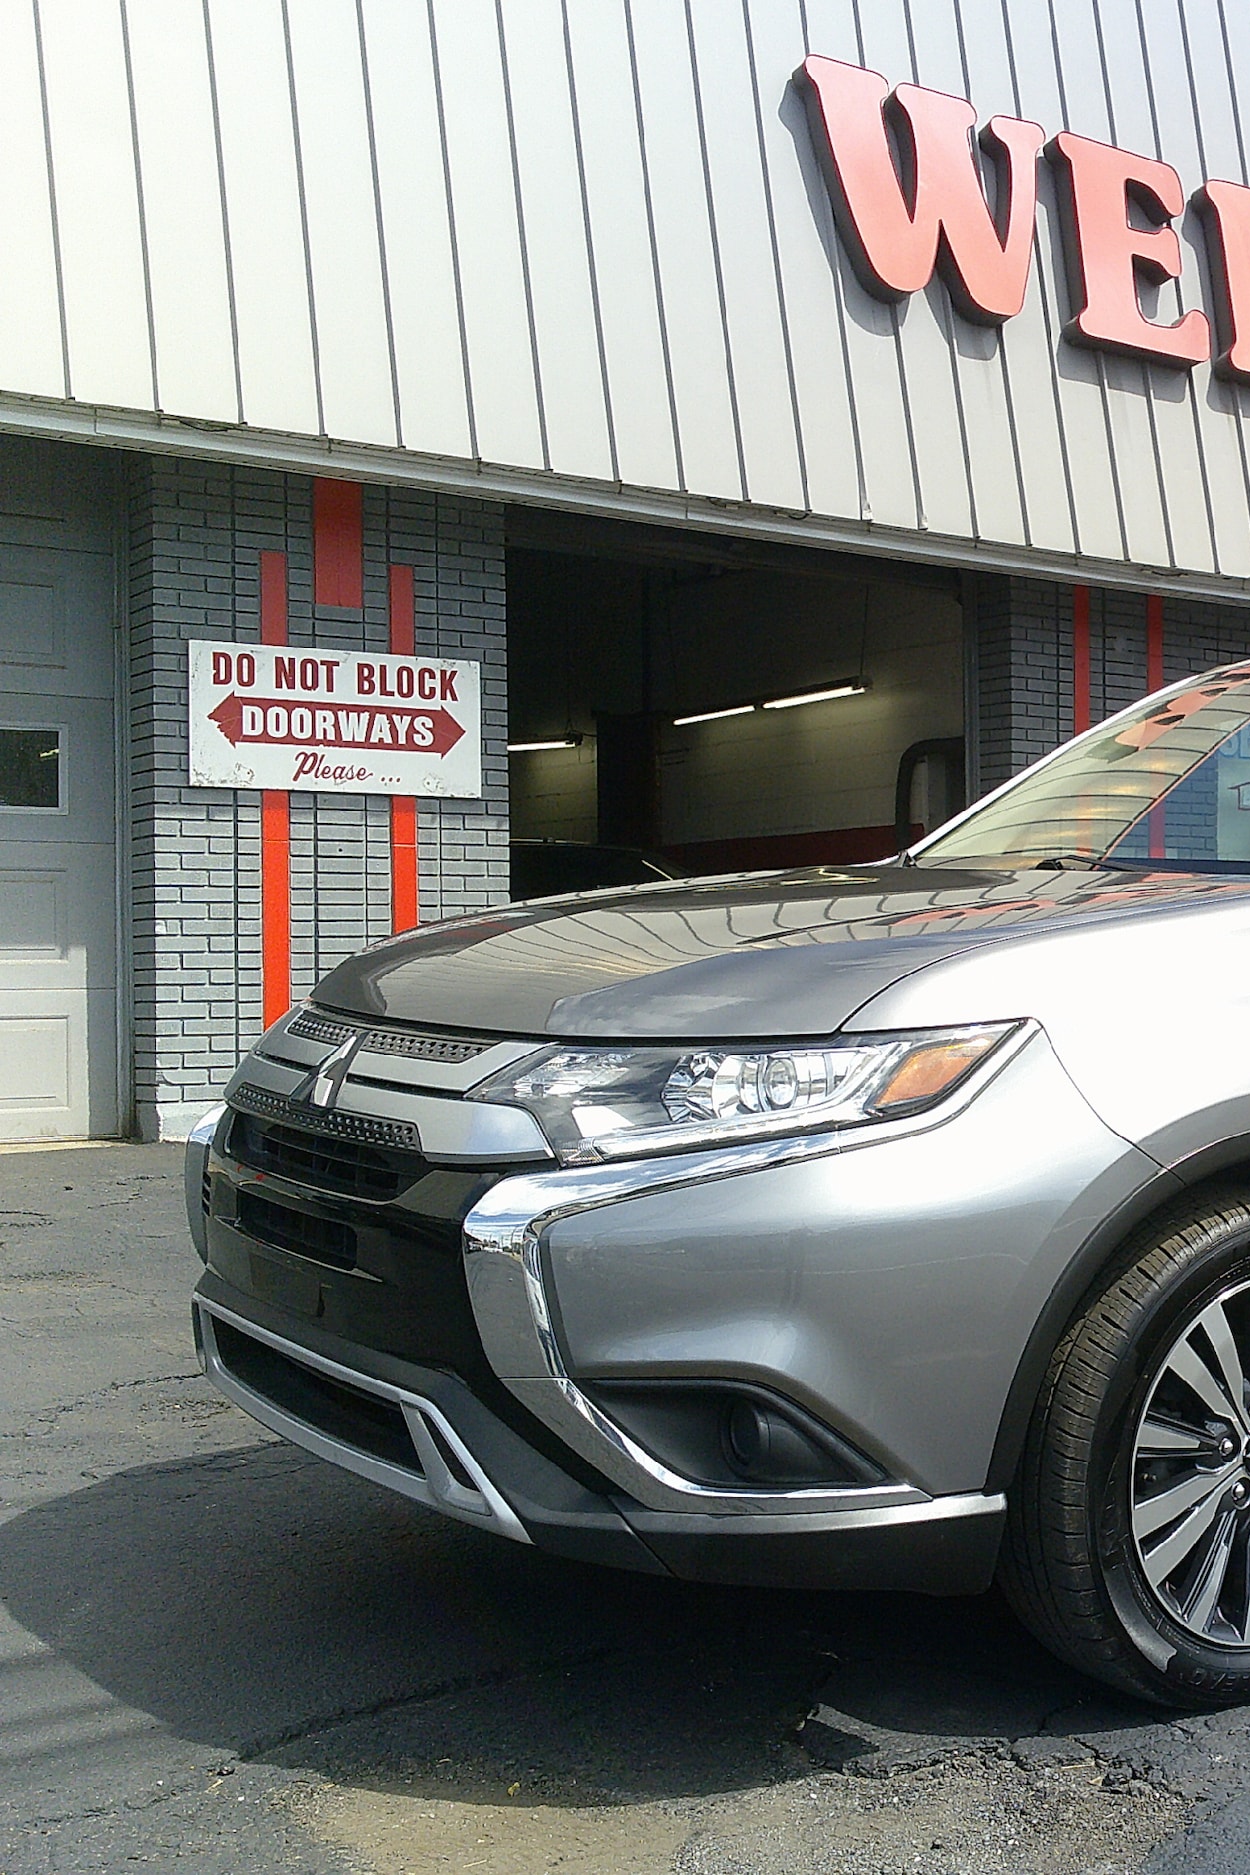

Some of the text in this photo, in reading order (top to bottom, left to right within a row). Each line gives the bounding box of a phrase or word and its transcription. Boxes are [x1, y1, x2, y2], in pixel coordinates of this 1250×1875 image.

[212, 651, 458, 701] DO NOT BLOCK
[242, 705, 434, 747] DOORWAYS
[293, 751, 373, 781] Please
